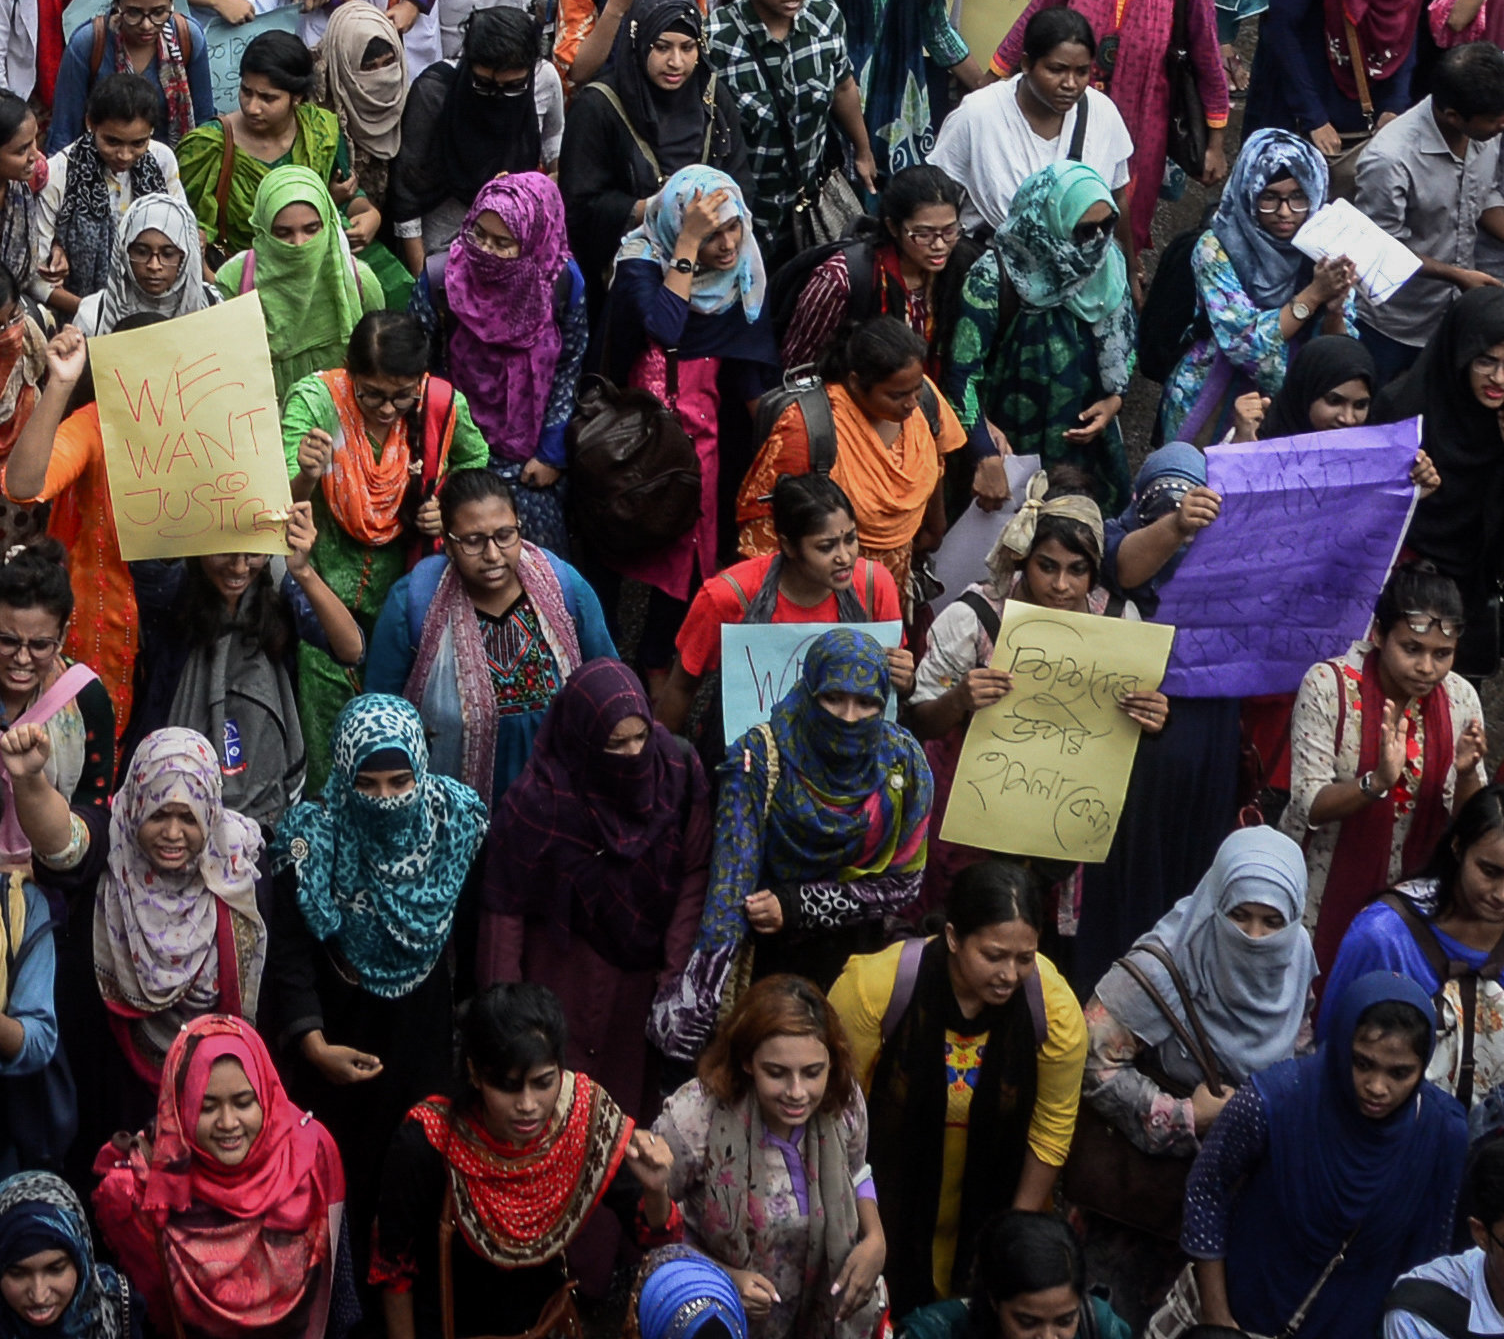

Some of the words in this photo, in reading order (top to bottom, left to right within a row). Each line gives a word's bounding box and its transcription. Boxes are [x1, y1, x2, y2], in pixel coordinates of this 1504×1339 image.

[114, 352, 244, 427] WE
[126, 407, 267, 480] WANT
[124, 471, 285, 539] JUSTICE
